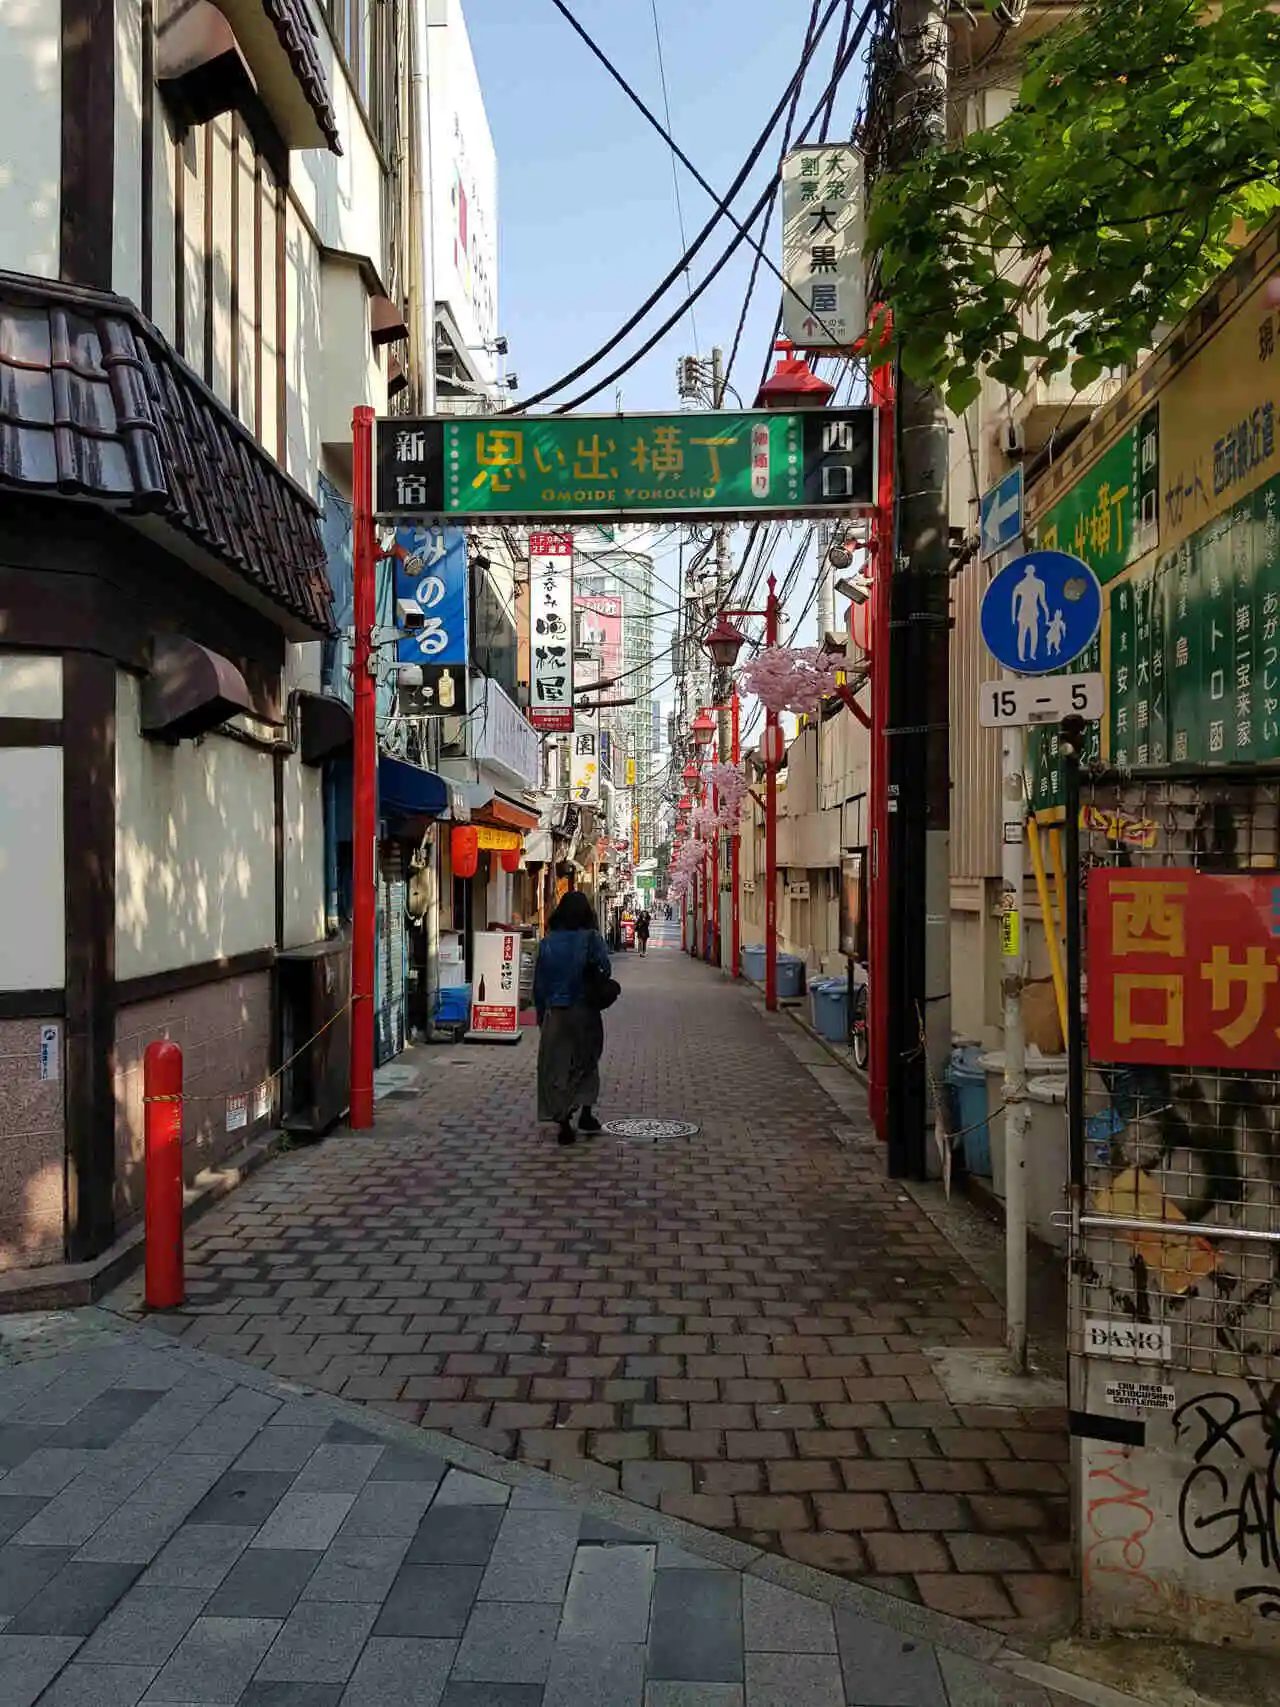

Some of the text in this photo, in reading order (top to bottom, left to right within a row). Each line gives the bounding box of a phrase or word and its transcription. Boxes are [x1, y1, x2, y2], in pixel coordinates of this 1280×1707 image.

[809, 205, 838, 312] 大黒屋
[396, 430, 426, 505] 新宿
[472, 426, 738, 492] 思い出横丁
[541, 487, 716, 501] OMOIDE YOKOCHO
[822, 420, 853, 497] 西口
[1142, 427, 1157, 530] 西口
[992, 690, 1016, 718] 15
[1071, 683, 1088, 710] 5
[1236, 604, 1251, 747] 第二宝来家
[1109, 879, 1189, 1047] 西口
[1200, 945, 1280, 1048] サ
[1091, 1327, 1164, 1352] DAMO
